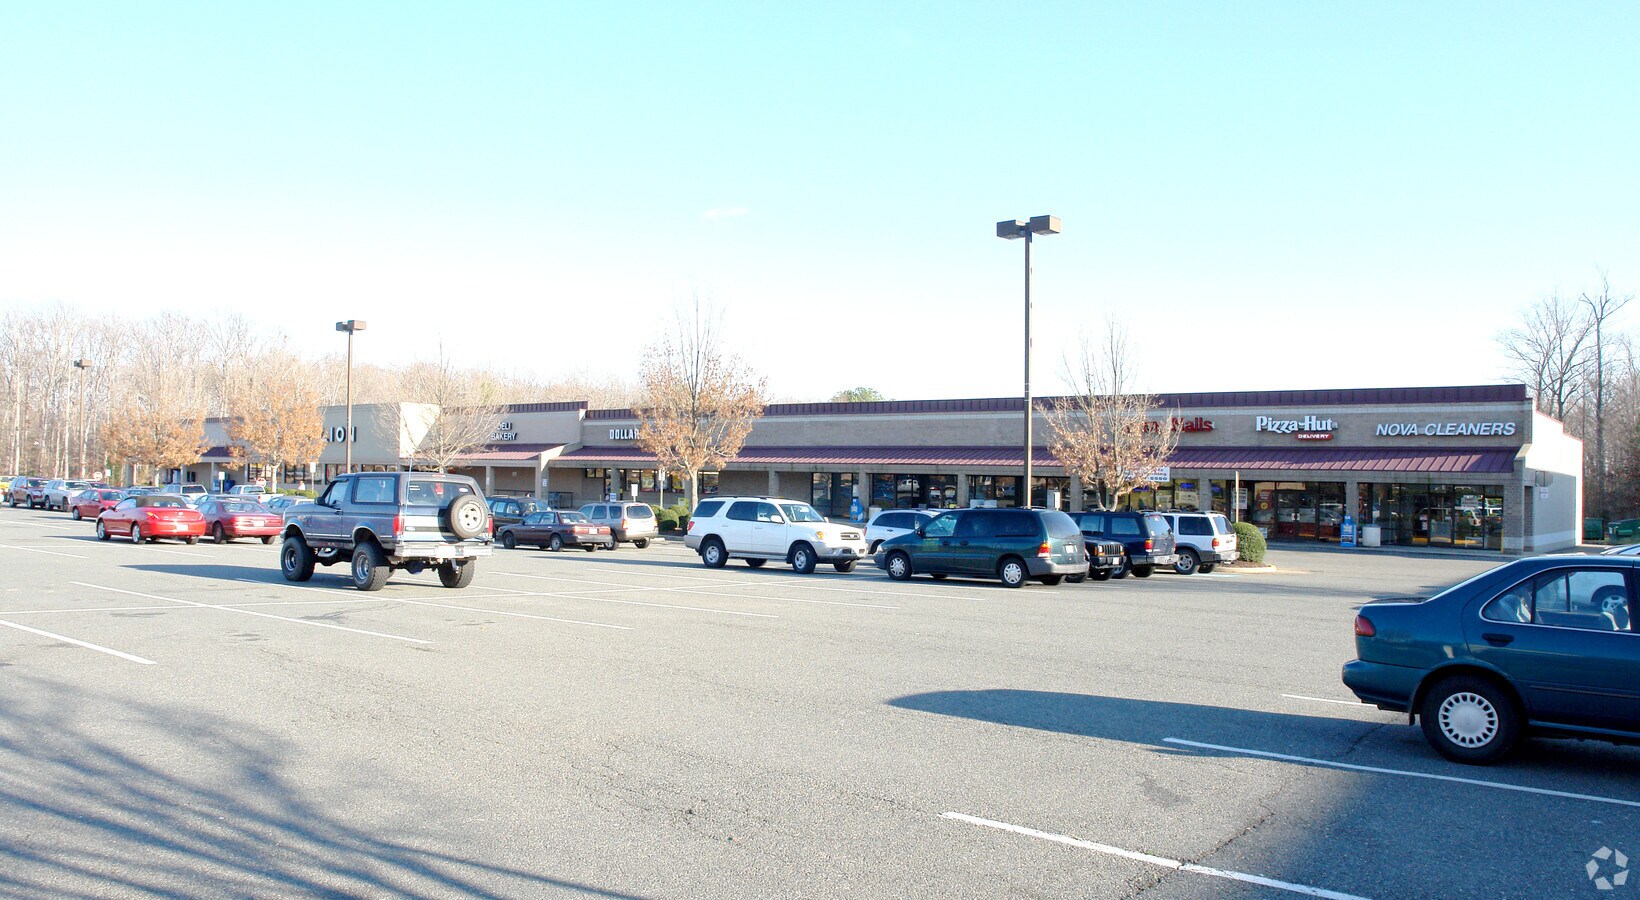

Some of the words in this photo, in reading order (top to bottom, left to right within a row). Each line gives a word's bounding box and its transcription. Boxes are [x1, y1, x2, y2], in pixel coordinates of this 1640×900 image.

[1171, 417, 1213, 432] Nails
[1256, 416, 1298, 433] Pizza
[1303, 416, 1333, 431] Hut
[1376, 423, 1418, 436] NOVA
[1424, 422, 1516, 436] CLEANERS
[491, 432, 517, 441] BAKERY
